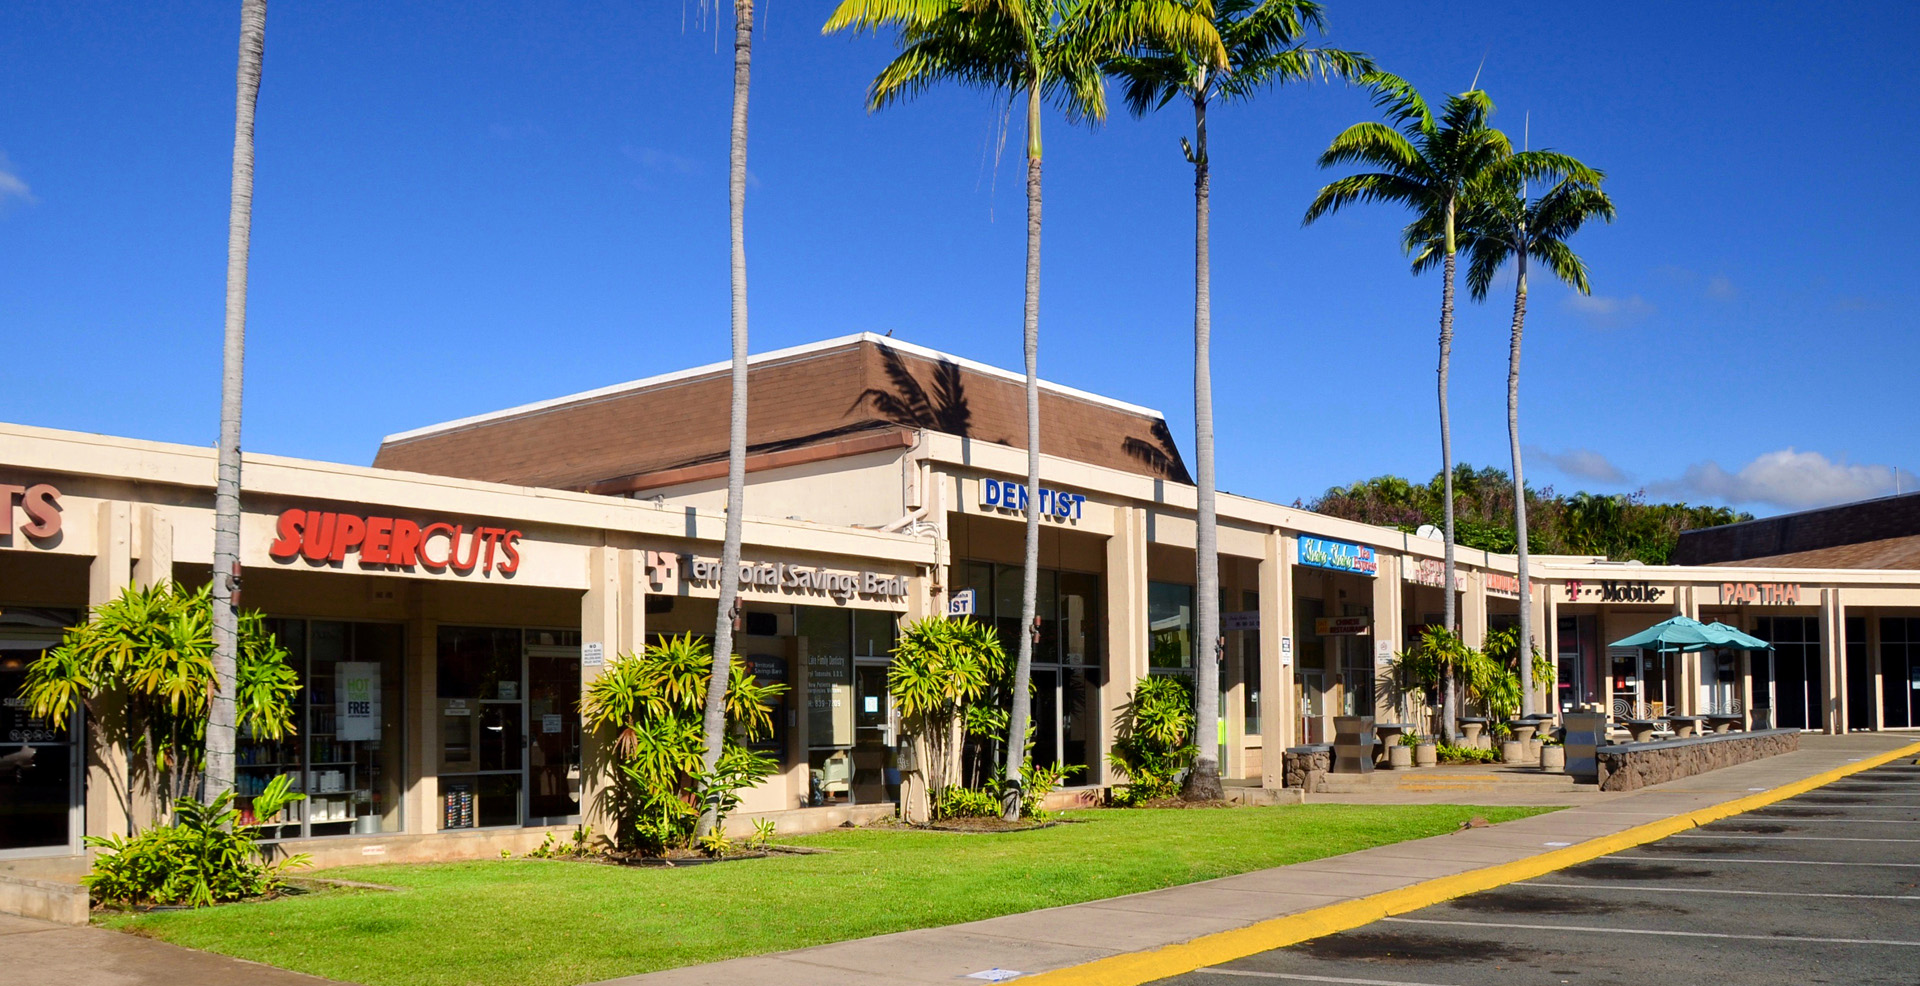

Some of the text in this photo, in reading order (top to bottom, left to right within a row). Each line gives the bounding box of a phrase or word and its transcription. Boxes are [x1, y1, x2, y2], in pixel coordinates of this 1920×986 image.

[979, 478, 1086, 519] DENTIST
[269, 508, 523, 574] SUPERCUTS
[1357, 545, 1371, 560] Tea
[1353, 556, 1377, 572] Express
[676, 554, 909, 598] Terorial Savings Bank
[1720, 583, 1801, 602] PAD THAI
[1329, 626, 1367, 634] RESTAURANT
[347, 678, 369, 692] HOT
[347, 701, 371, 715] FREE
